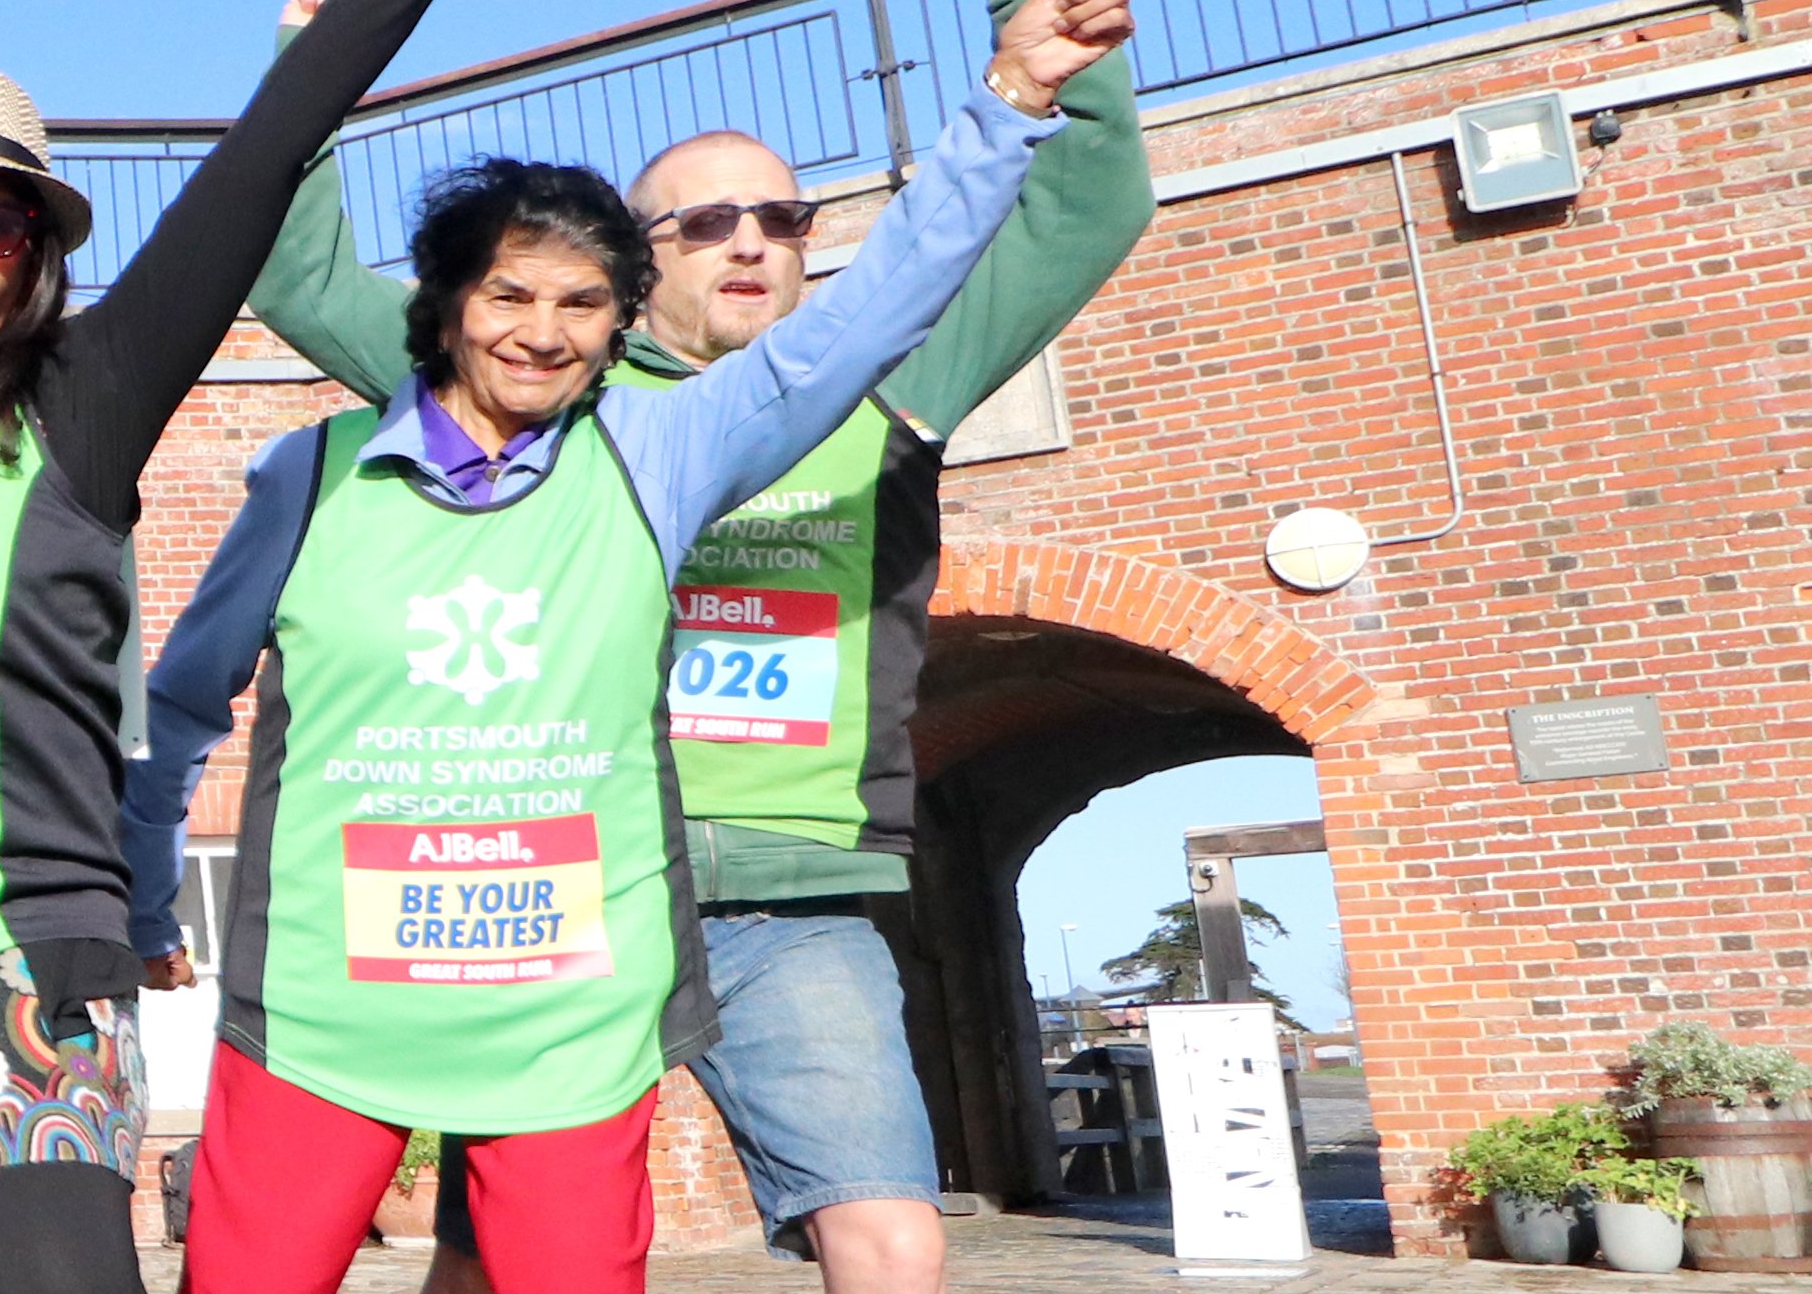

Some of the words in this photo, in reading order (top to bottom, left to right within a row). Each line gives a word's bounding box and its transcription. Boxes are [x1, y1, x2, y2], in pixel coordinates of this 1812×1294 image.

[709, 519, 858, 543] YNDROME
[677, 648, 789, 700] 026
[694, 718, 749, 737] SOUTH
[750, 721, 786, 739] RUN
[1532, 714, 1555, 724] THE
[1557, 706, 1635, 721] INSCRIPTION
[355, 720, 586, 750] PORTSMOUTH
[323, 759, 421, 785] DOWN
[431, 751, 614, 784] SYNDROME
[353, 789, 582, 817] ASSOCIATION
[400, 884, 443, 914] BE
[457, 879, 554, 913] YOUR
[395, 912, 564, 948] GREATEST
[409, 962, 462, 980] GREAT
[463, 961, 515, 979] SOUTH
[517, 959, 553, 977] RUN
